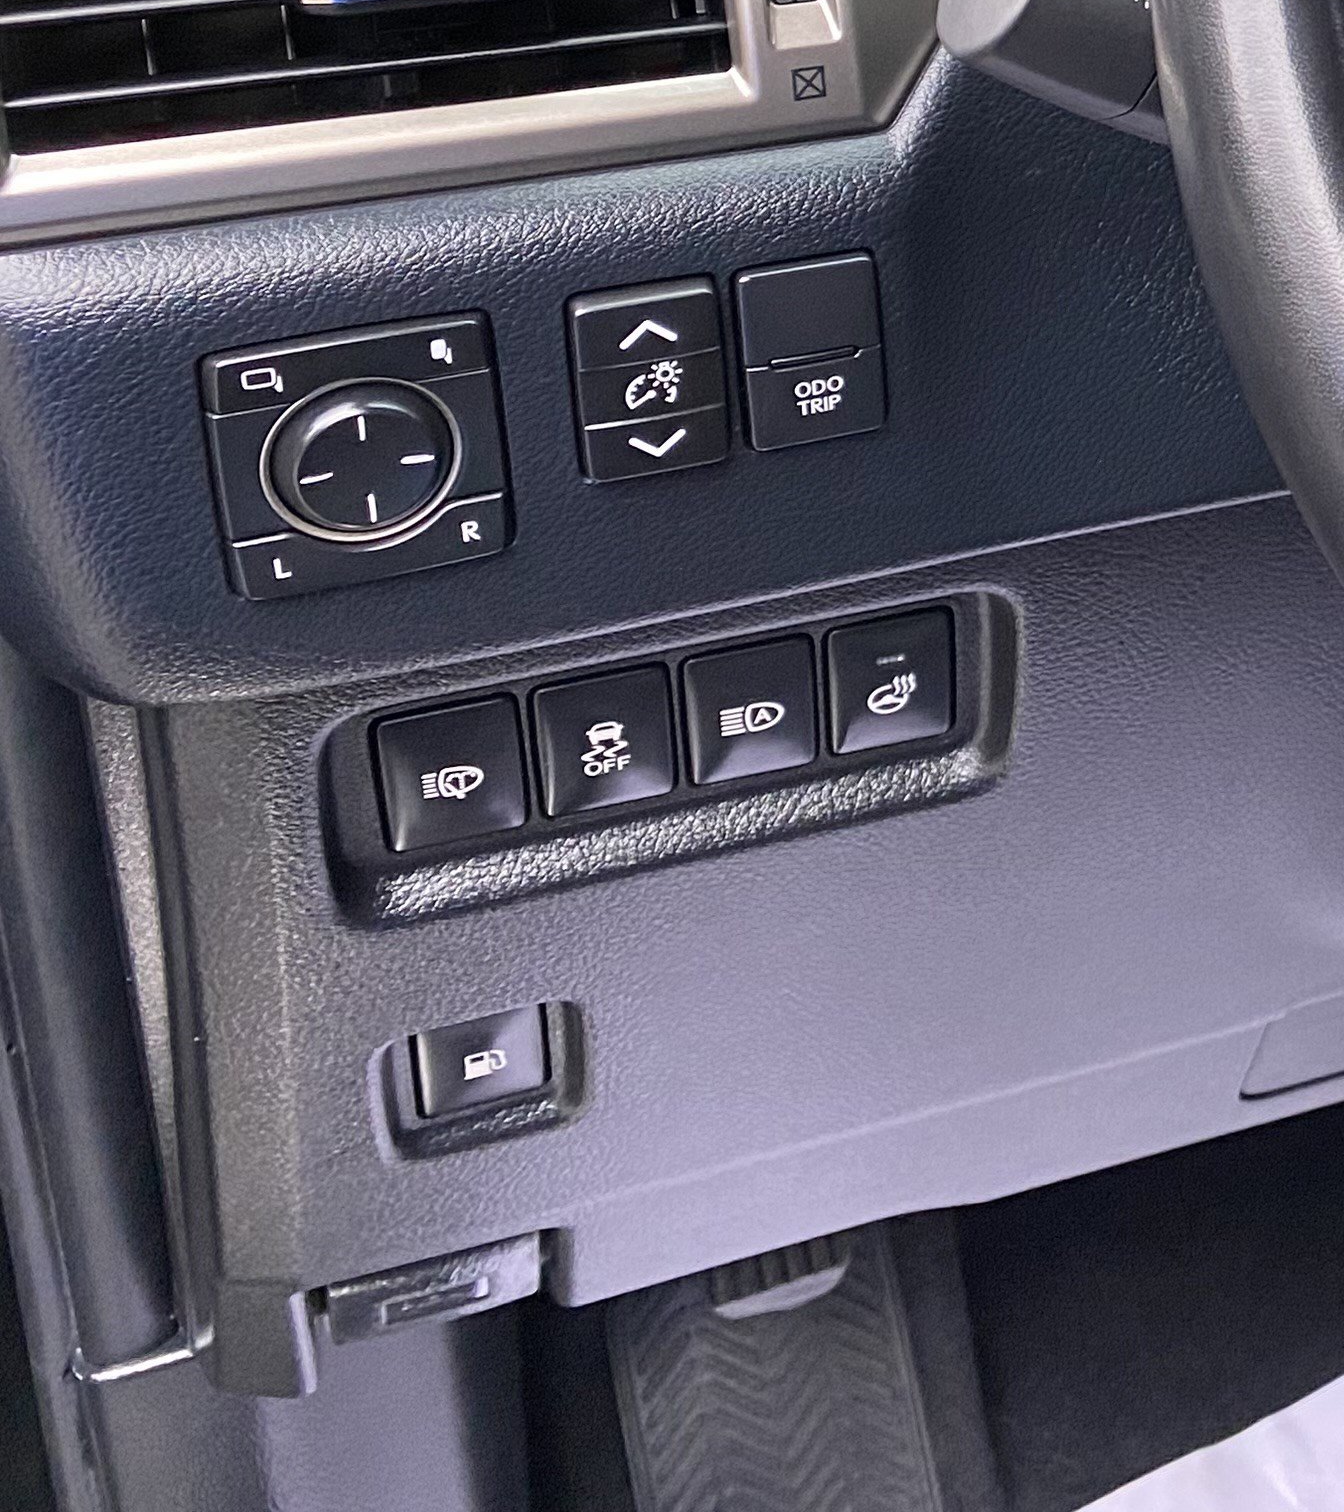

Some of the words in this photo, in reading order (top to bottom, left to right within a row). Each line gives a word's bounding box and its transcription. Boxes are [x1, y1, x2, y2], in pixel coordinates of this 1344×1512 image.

[794, 374, 844, 398] ODO
[796, 392, 843, 417] TRIP
[461, 522, 480, 543] R
[272, 556, 293, 580] L
[582, 754, 631, 778] OFF
